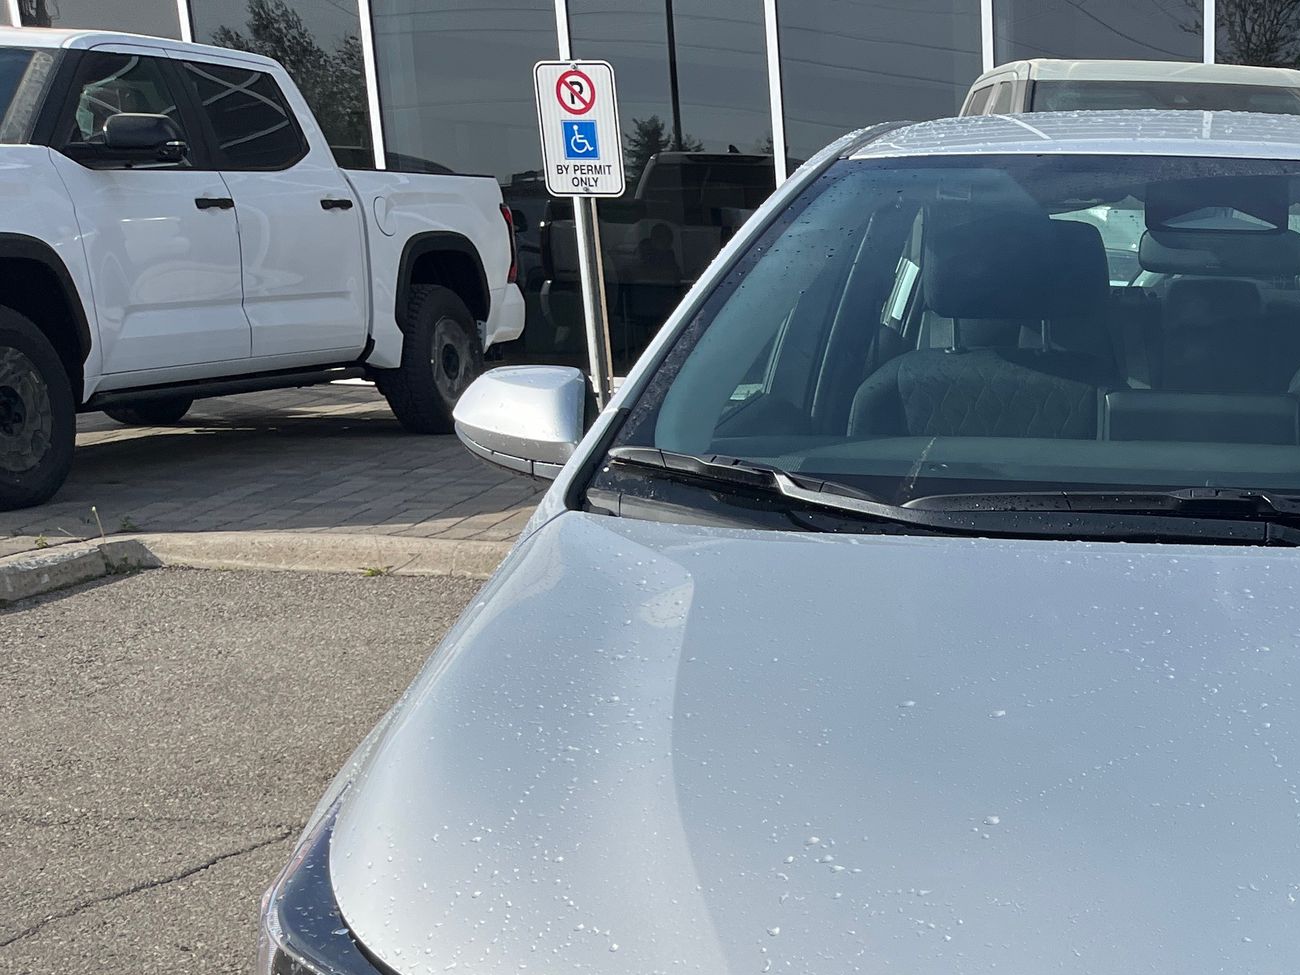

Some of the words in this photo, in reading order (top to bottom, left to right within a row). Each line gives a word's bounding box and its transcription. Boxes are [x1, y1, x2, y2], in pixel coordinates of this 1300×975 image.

[556, 164, 569, 175] BY
[573, 165, 612, 175] PERMIT
[571, 177, 599, 187] ONLY
